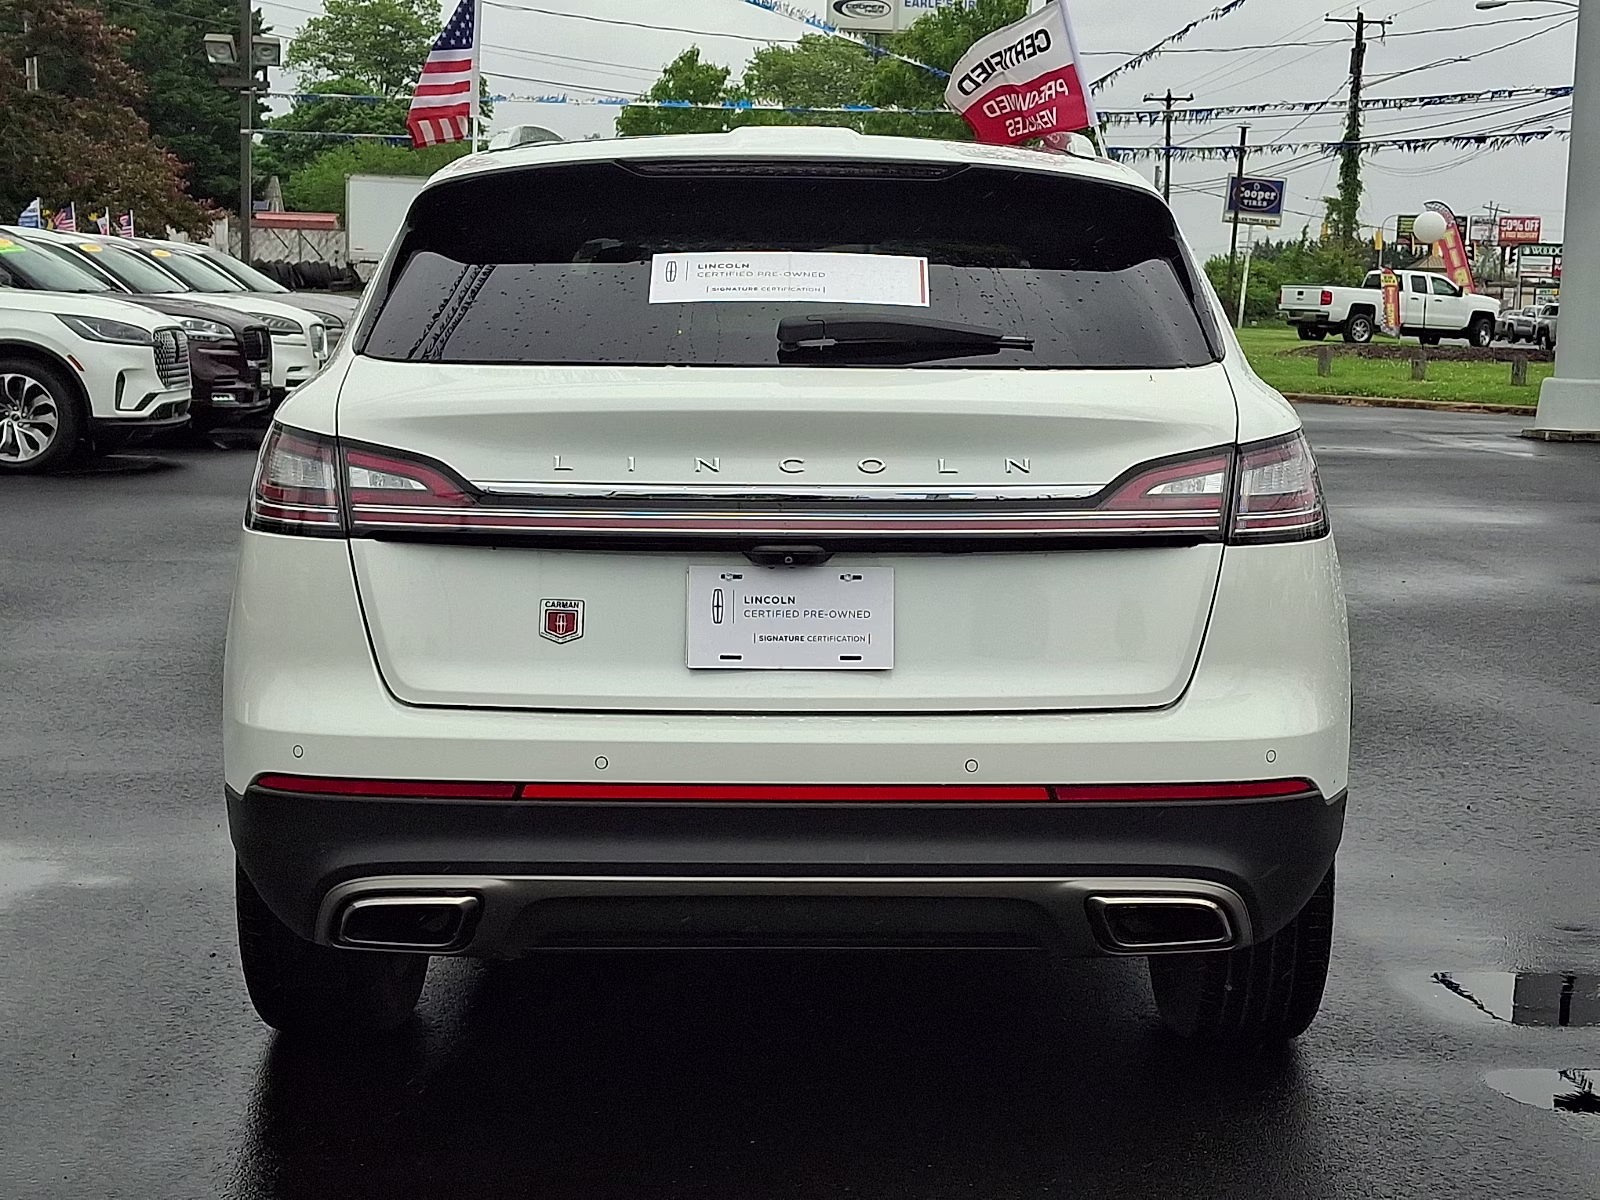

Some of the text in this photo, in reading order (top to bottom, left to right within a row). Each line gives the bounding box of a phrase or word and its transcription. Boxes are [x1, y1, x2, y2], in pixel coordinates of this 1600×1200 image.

[1501, 218, 1540, 232] 50% OFF
[757, 270, 826, 278] PRE-OWNED
[553, 454, 1031, 475] LINCOLN
[743, 596, 796, 605] LINCOLN
[743, 609, 871, 618] CERTIFIED PRE-OWNED
